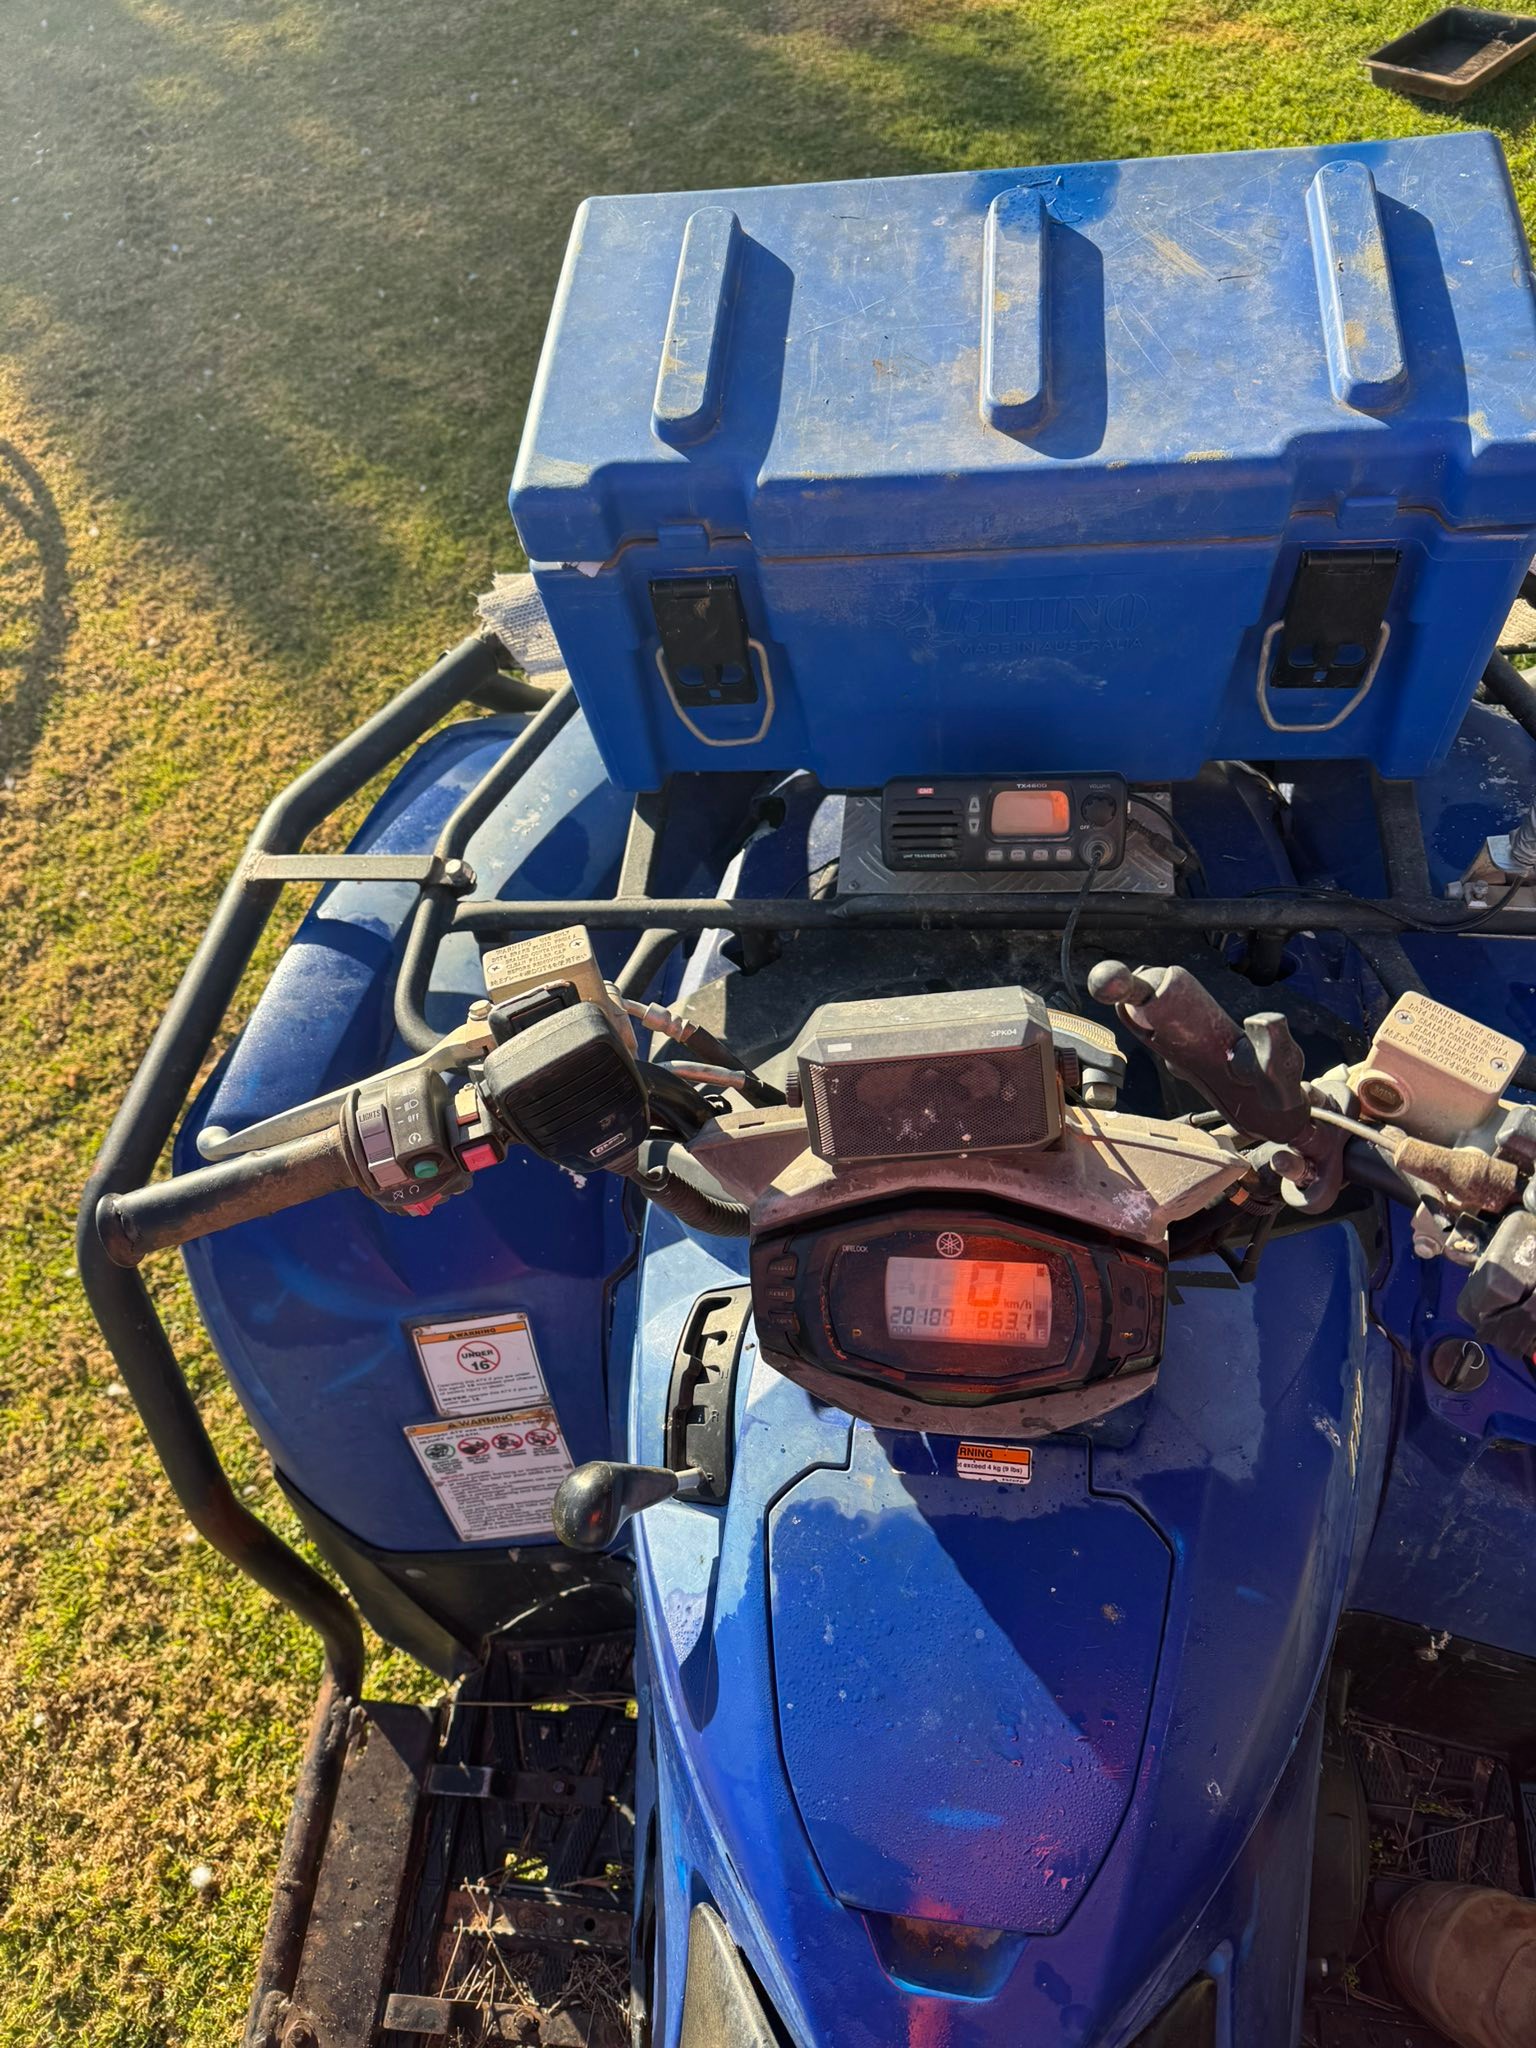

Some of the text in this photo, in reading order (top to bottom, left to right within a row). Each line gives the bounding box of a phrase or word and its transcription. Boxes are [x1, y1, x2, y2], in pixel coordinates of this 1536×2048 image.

[939, 592, 1149, 635] RHINO
[958, 637, 1143, 656] MADE IN AUSTRALIA
[1418, 999, 1462, 1024] WARNING
[990, 1029, 1017, 1038] SPK04
[358, 1109, 381, 1122] LIGHTS
[407, 1113, 420, 1123] OFF
[967, 1261, 1004, 1308] 0
[1003, 1298, 1032, 1311] km/h
[456, 1327, 496, 1337] WARNING
[1038, 1328, 1046, 1340] E
[461, 1349, 493, 1358] UNDER
[471, 1360, 490, 1370] 16
[460, 1414, 513, 1426] WARNING
[993, 1464, 1001, 1473] kg
[1002, 1465, 1009, 1473] (9
[1010, 1466, 1023, 1474] lbs)
